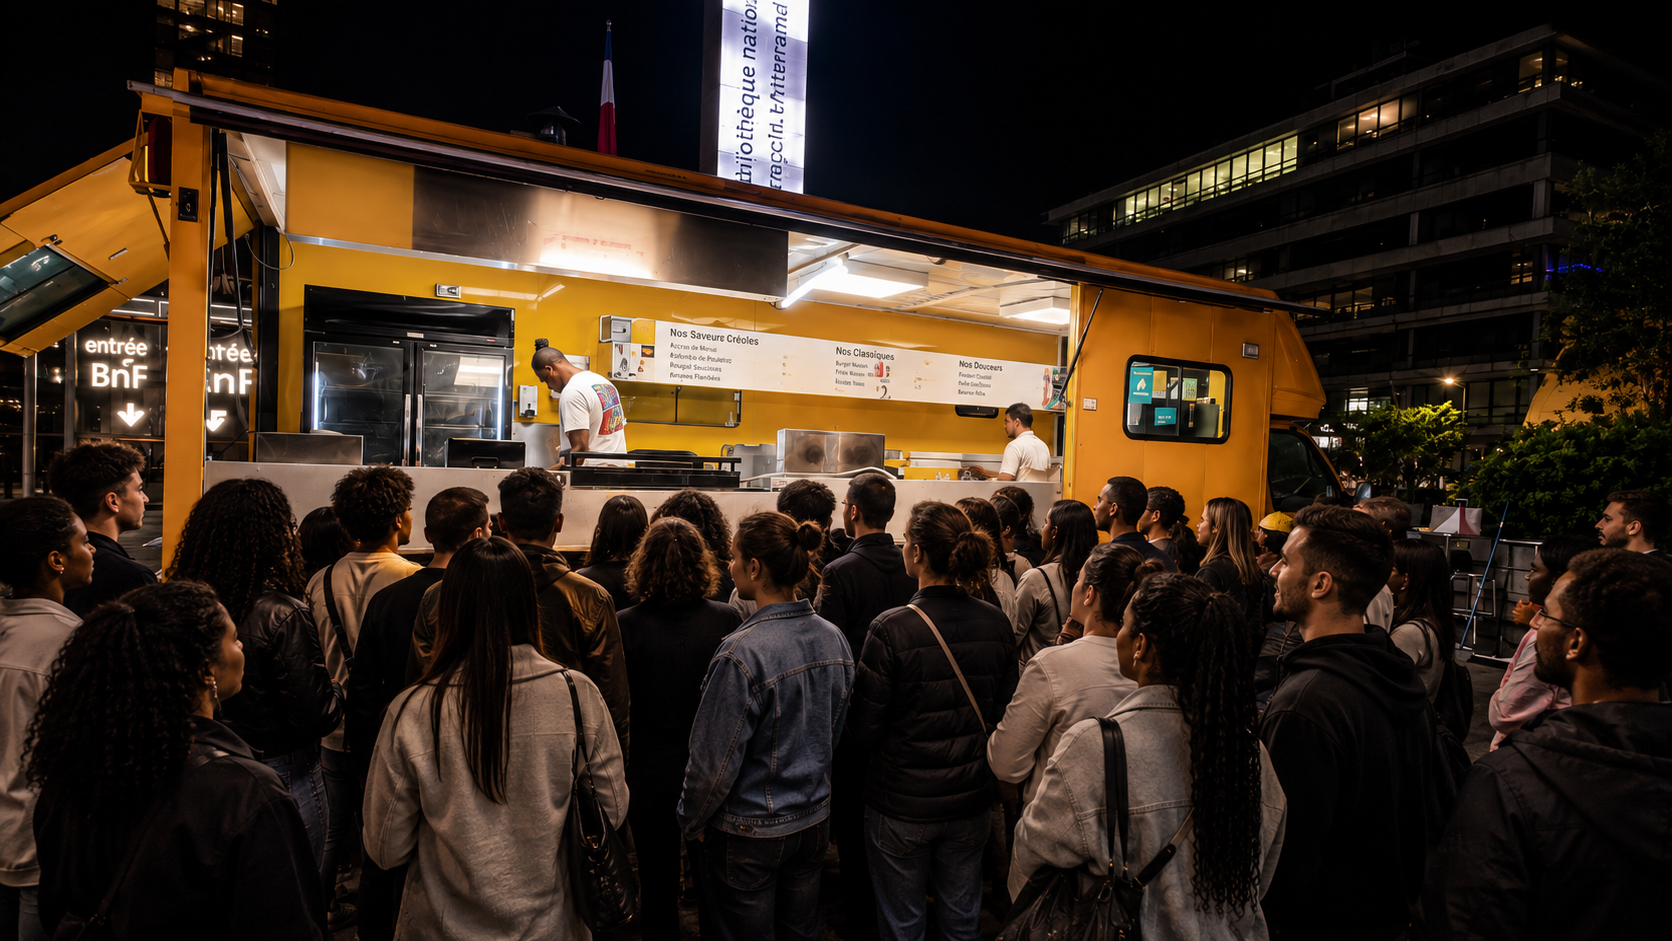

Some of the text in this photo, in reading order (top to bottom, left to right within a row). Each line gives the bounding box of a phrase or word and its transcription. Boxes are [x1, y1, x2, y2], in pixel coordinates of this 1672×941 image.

[670, 328, 688, 339] Nos
[726, 334, 759, 346] Créoles
[85, 337, 148, 357] entrée
[836, 346, 852, 356] Nos
[959, 360, 973, 369] Nos
[91, 362, 148, 389] BnF
[207, 368, 253, 395] nF
